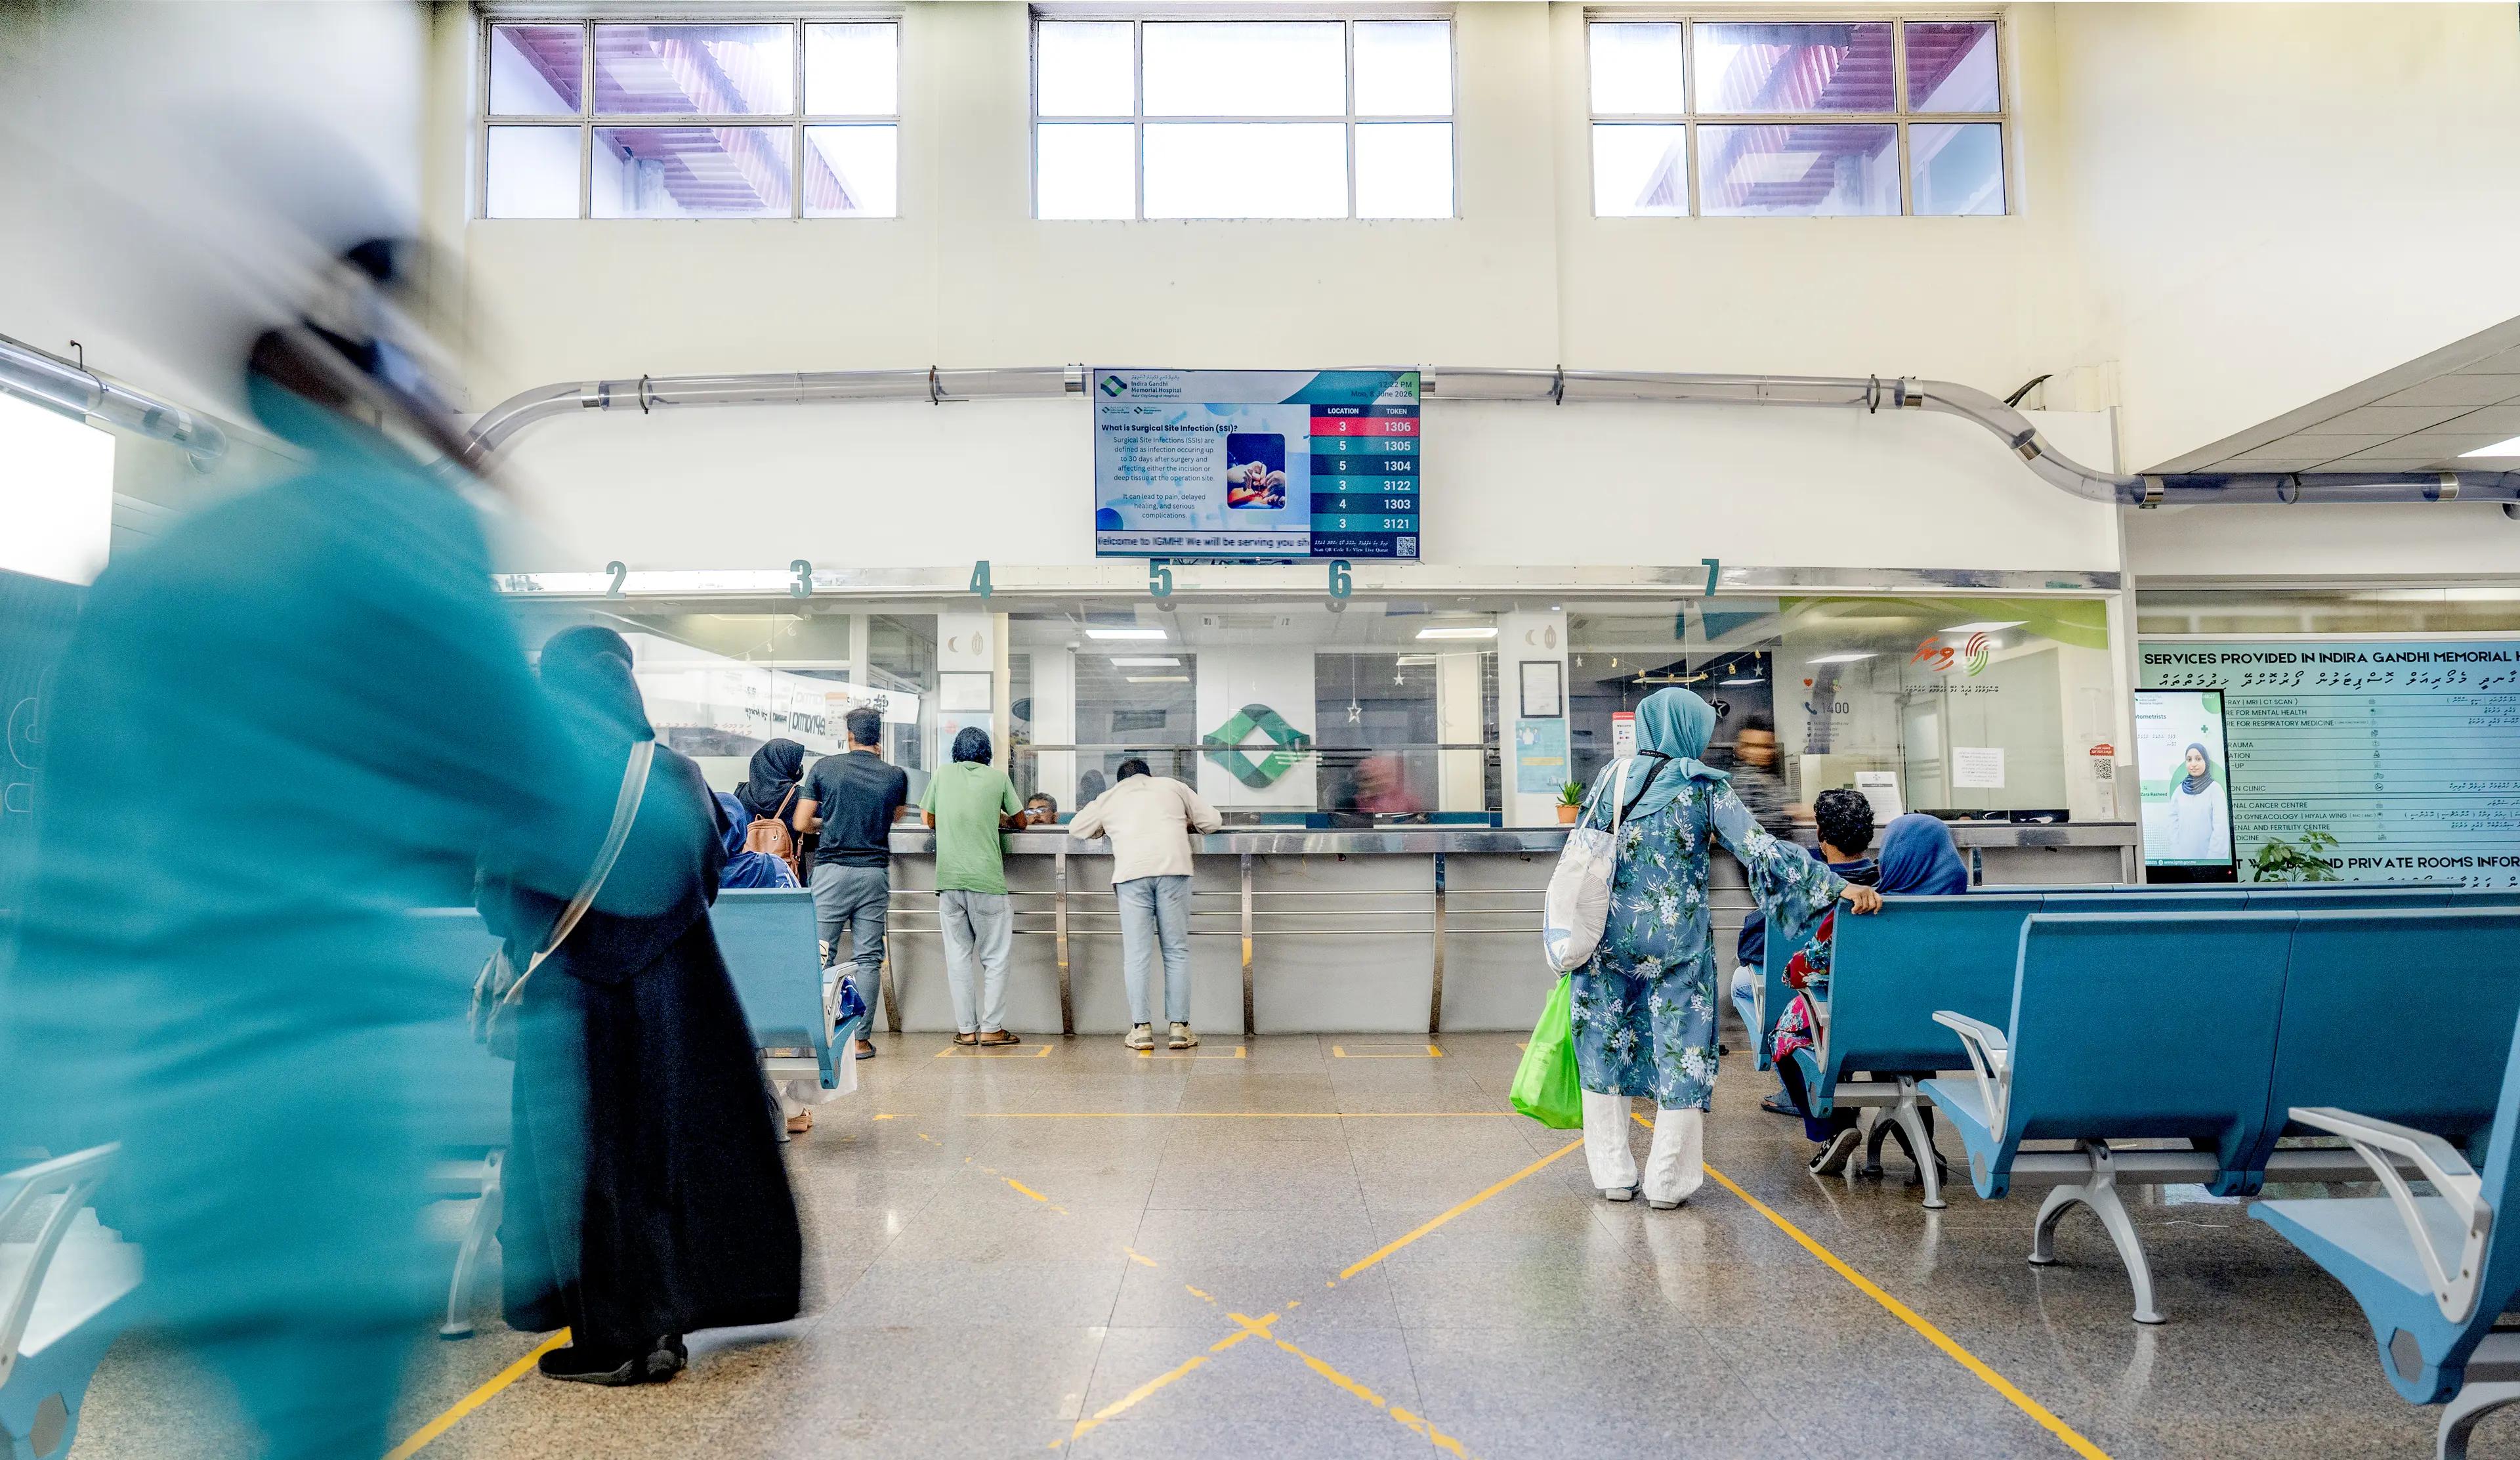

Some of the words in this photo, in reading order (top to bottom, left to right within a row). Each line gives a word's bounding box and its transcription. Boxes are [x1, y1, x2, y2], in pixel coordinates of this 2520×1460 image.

[1131, 425, 1163, 433] Surgical
[1215, 425, 1238, 433] (SSI)?
[1339, 421, 1346, 431] 3
[1384, 421, 1411, 432] 1306
[1339, 440, 1346, 451] 5
[1384, 441, 1411, 451] 1305
[1339, 460, 1347, 471] 5
[1384, 461, 1411, 471] 1304
[1339, 481, 1346, 490] 3
[1383, 481, 1411, 490] 3122
[1339, 499, 1347, 509] 4
[1384, 499, 1411, 509] 1303
[1339, 519, 1346, 528] 3
[1383, 519, 1410, 529] 3121
[1223, 537, 1235, 546] be
[1238, 538, 1273, 549] serving
[1276, 540, 1294, 548] you
[606, 561, 627, 599] 2
[789, 559, 812, 599] 3
[969, 560, 993, 599] 4
[1149, 558, 1172, 598] 5
[1328, 559, 1352, 599] 6
[1702, 558, 1719, 596] 7
[2144, 653, 2217, 664] SERVICES
[2221, 653, 2297, 664] PROVIDED
[2301, 653, 2315, 663] IN
[2319, 652, 2368, 663] INDIRA
[2372, 652, 2430, 663] GANDHI
[2433, 651, 2512, 662] MEMORIAL
[1822, 702, 1849, 714] 1400
[2323, 858, 2344, 869] ND
[2348, 857, 2414, 869] PRIVATE
[2418, 856, 2473, 868] ROOMS
[2477, 856, 2520, 867] INFOR
